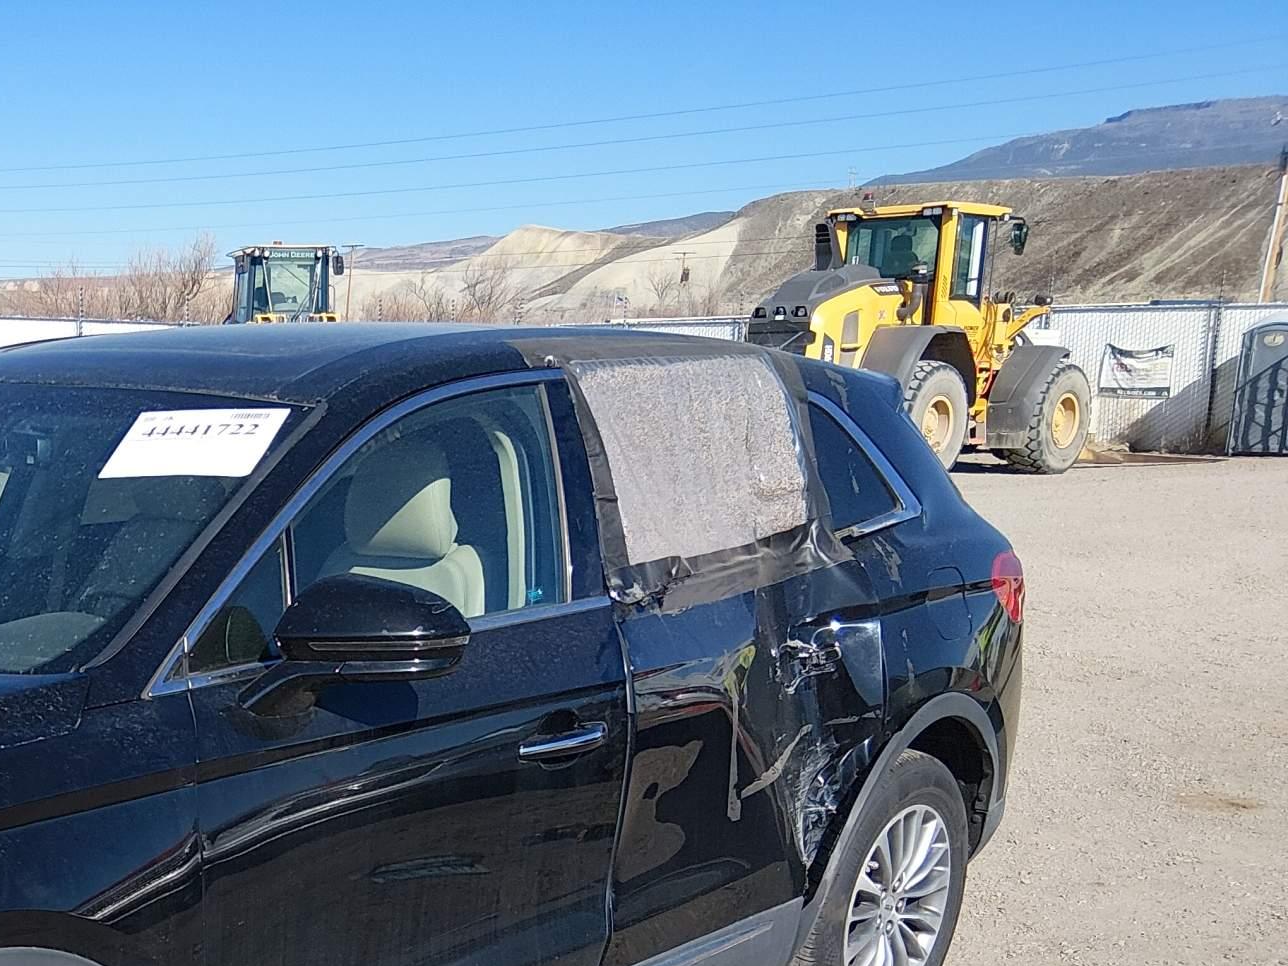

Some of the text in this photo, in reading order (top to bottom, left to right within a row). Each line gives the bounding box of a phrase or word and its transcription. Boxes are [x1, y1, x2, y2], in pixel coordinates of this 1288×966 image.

[270, 250, 315, 258] JOHN DEERE
[142, 424, 259, 437] 44441722
